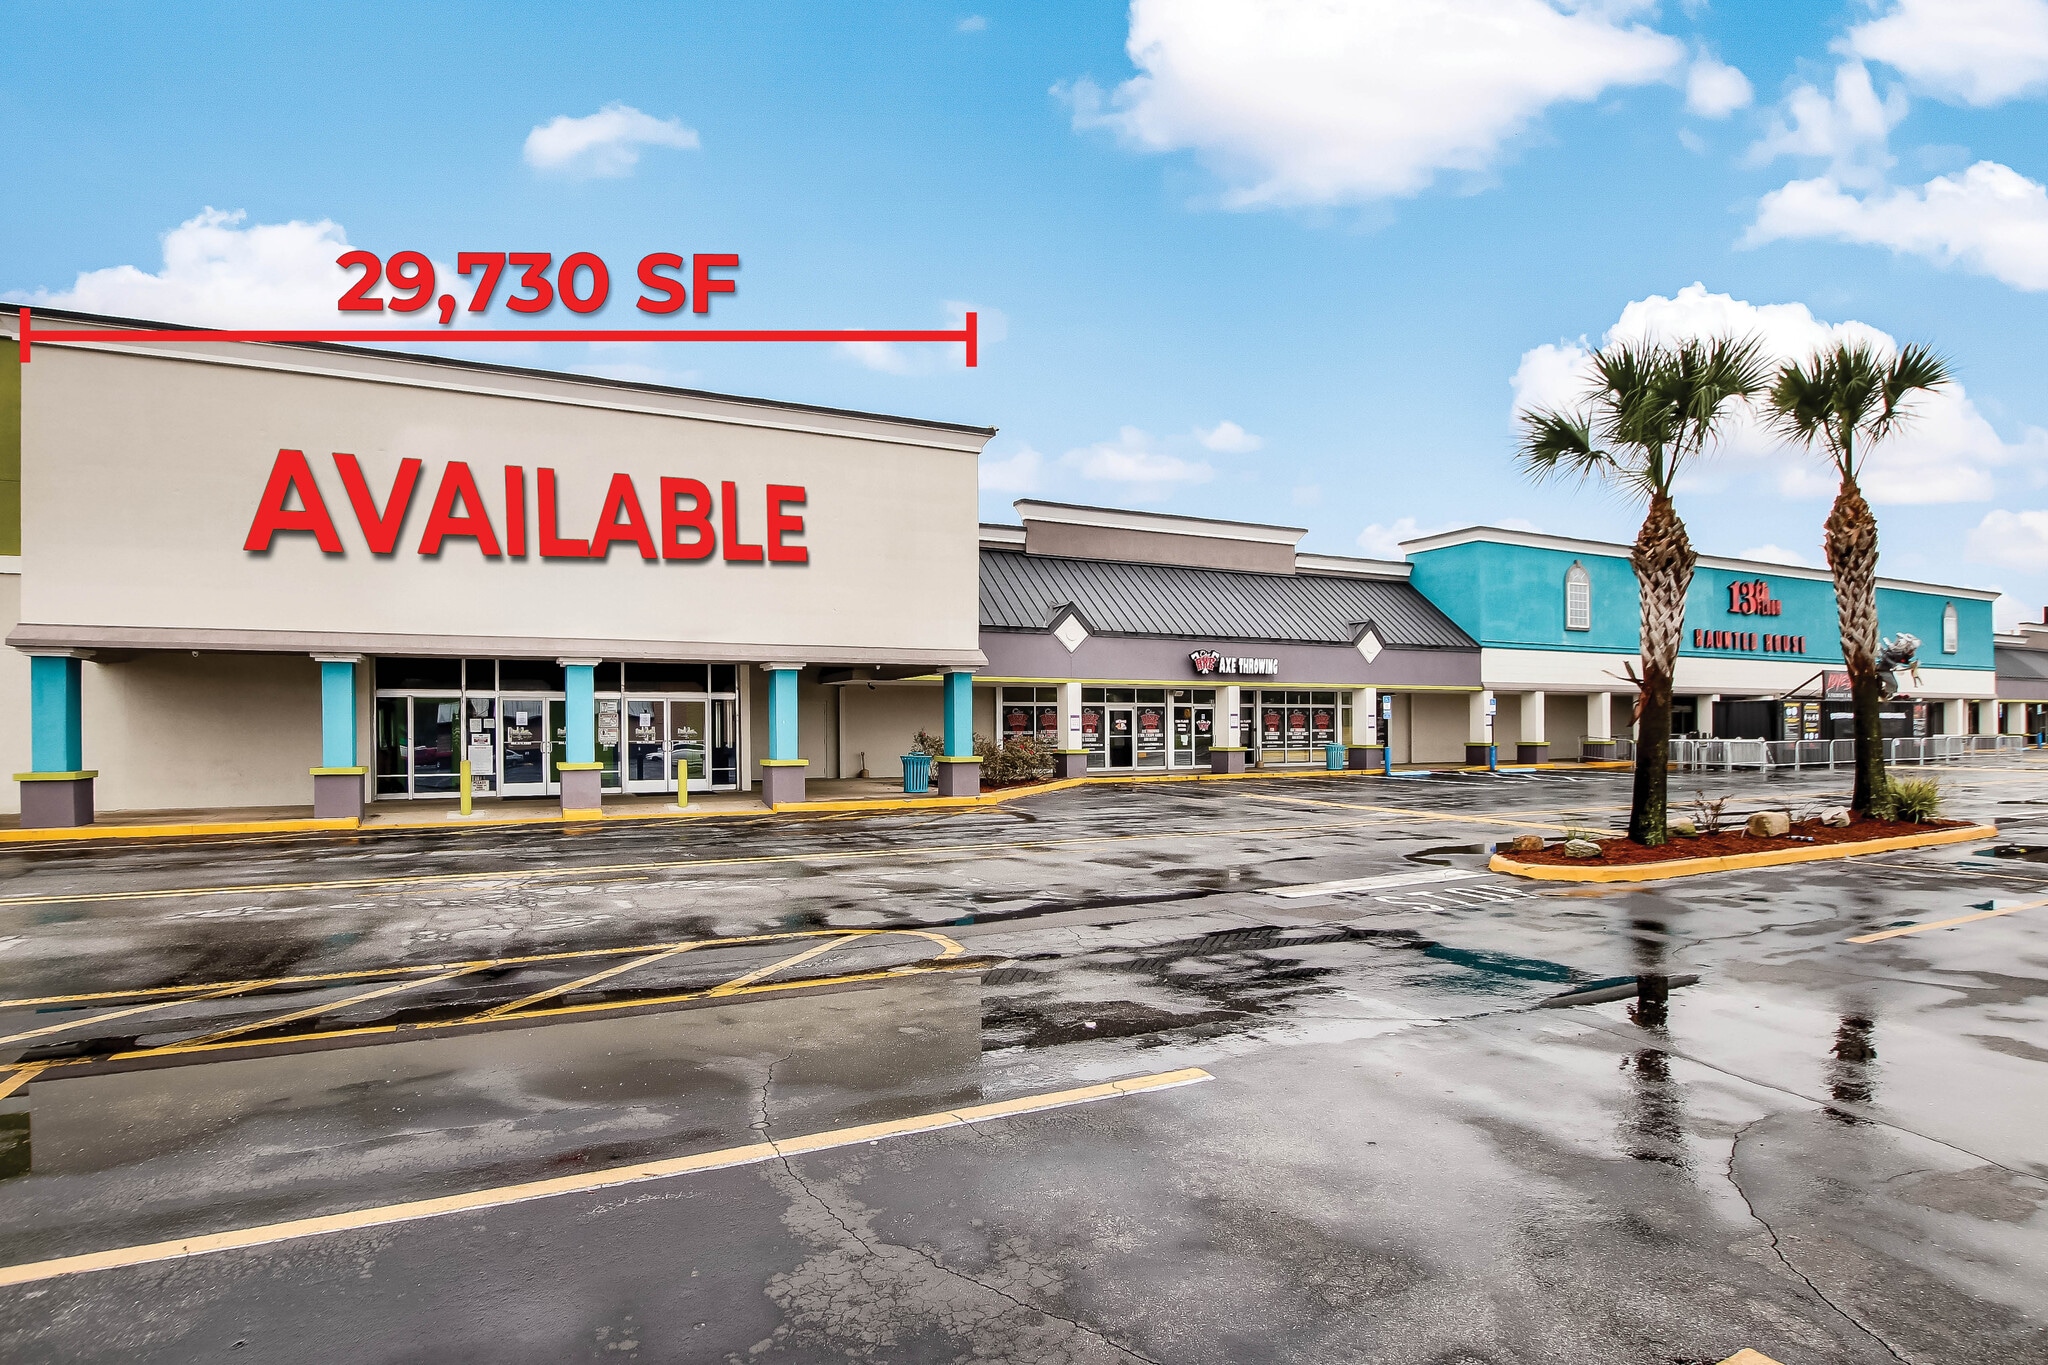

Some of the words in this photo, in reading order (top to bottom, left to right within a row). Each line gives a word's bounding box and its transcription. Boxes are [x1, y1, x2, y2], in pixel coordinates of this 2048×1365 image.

[1694, 628, 1758, 651] HAUNTED
[1763, 633, 1806, 654] HOUSE
[1218, 656, 1237, 674] AXE
[1238, 657, 1279, 675] THROWING
[1373, 884, 1540, 913] STOP
